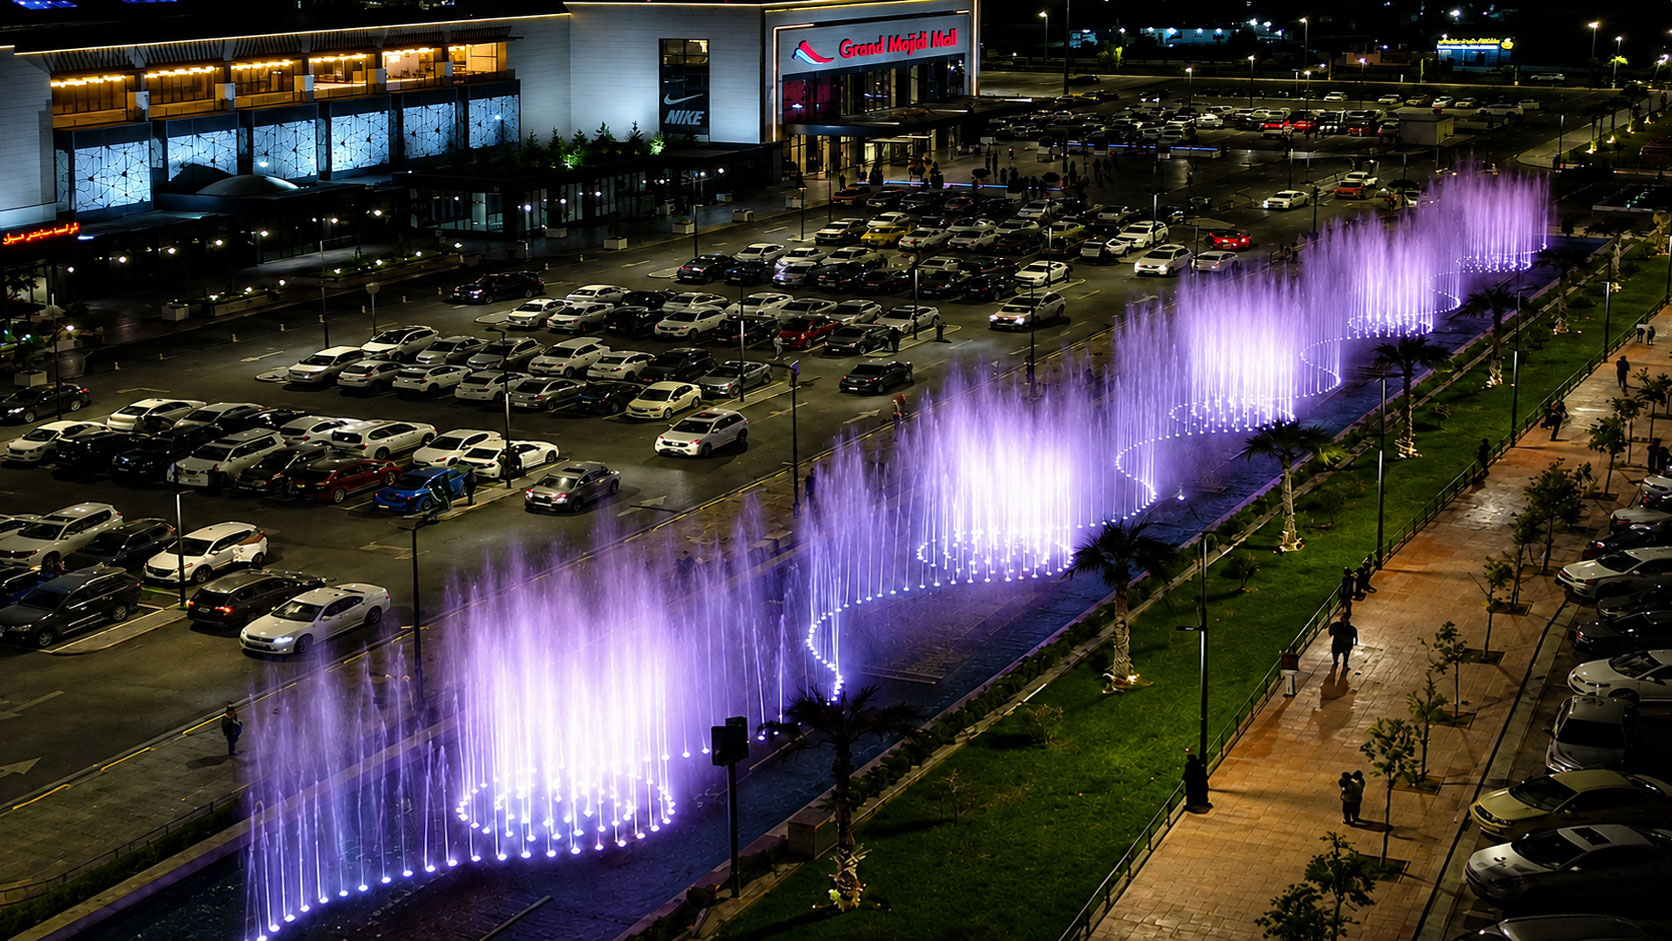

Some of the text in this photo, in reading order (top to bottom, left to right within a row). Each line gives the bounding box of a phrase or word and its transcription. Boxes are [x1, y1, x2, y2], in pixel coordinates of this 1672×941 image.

[840, 28, 958, 58] Grand Majidi Mall
[664, 109, 705, 125] NIKE
